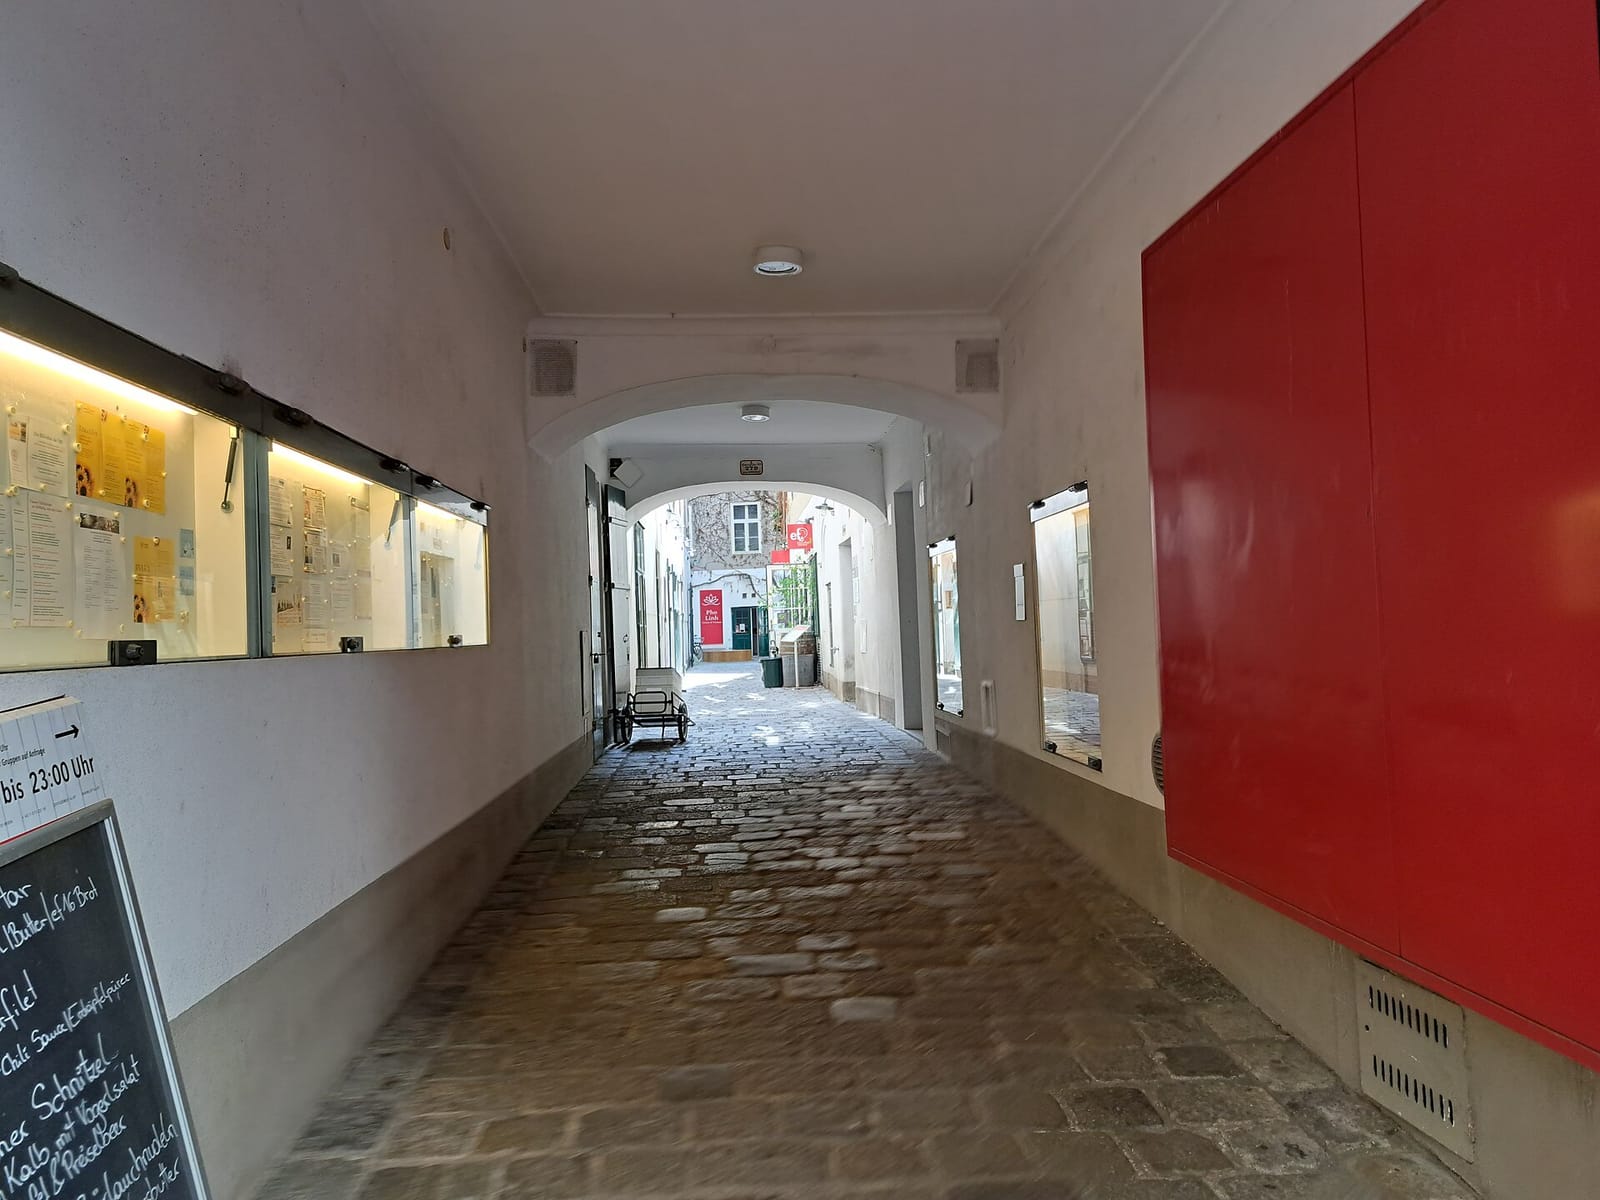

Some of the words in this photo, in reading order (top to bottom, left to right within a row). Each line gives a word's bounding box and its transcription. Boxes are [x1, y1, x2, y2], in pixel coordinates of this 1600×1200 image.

[0, 778, 24, 804] bis
[29, 761, 70, 794] 23:00
[70, 754, 94, 779] Uhr
[73, 876, 99, 908] Brot
[31, 1032, 112, 1121] Schnitzel
[3, 1142, 51, 1194] Kalb
[55, 1111, 77, 1150] mit
